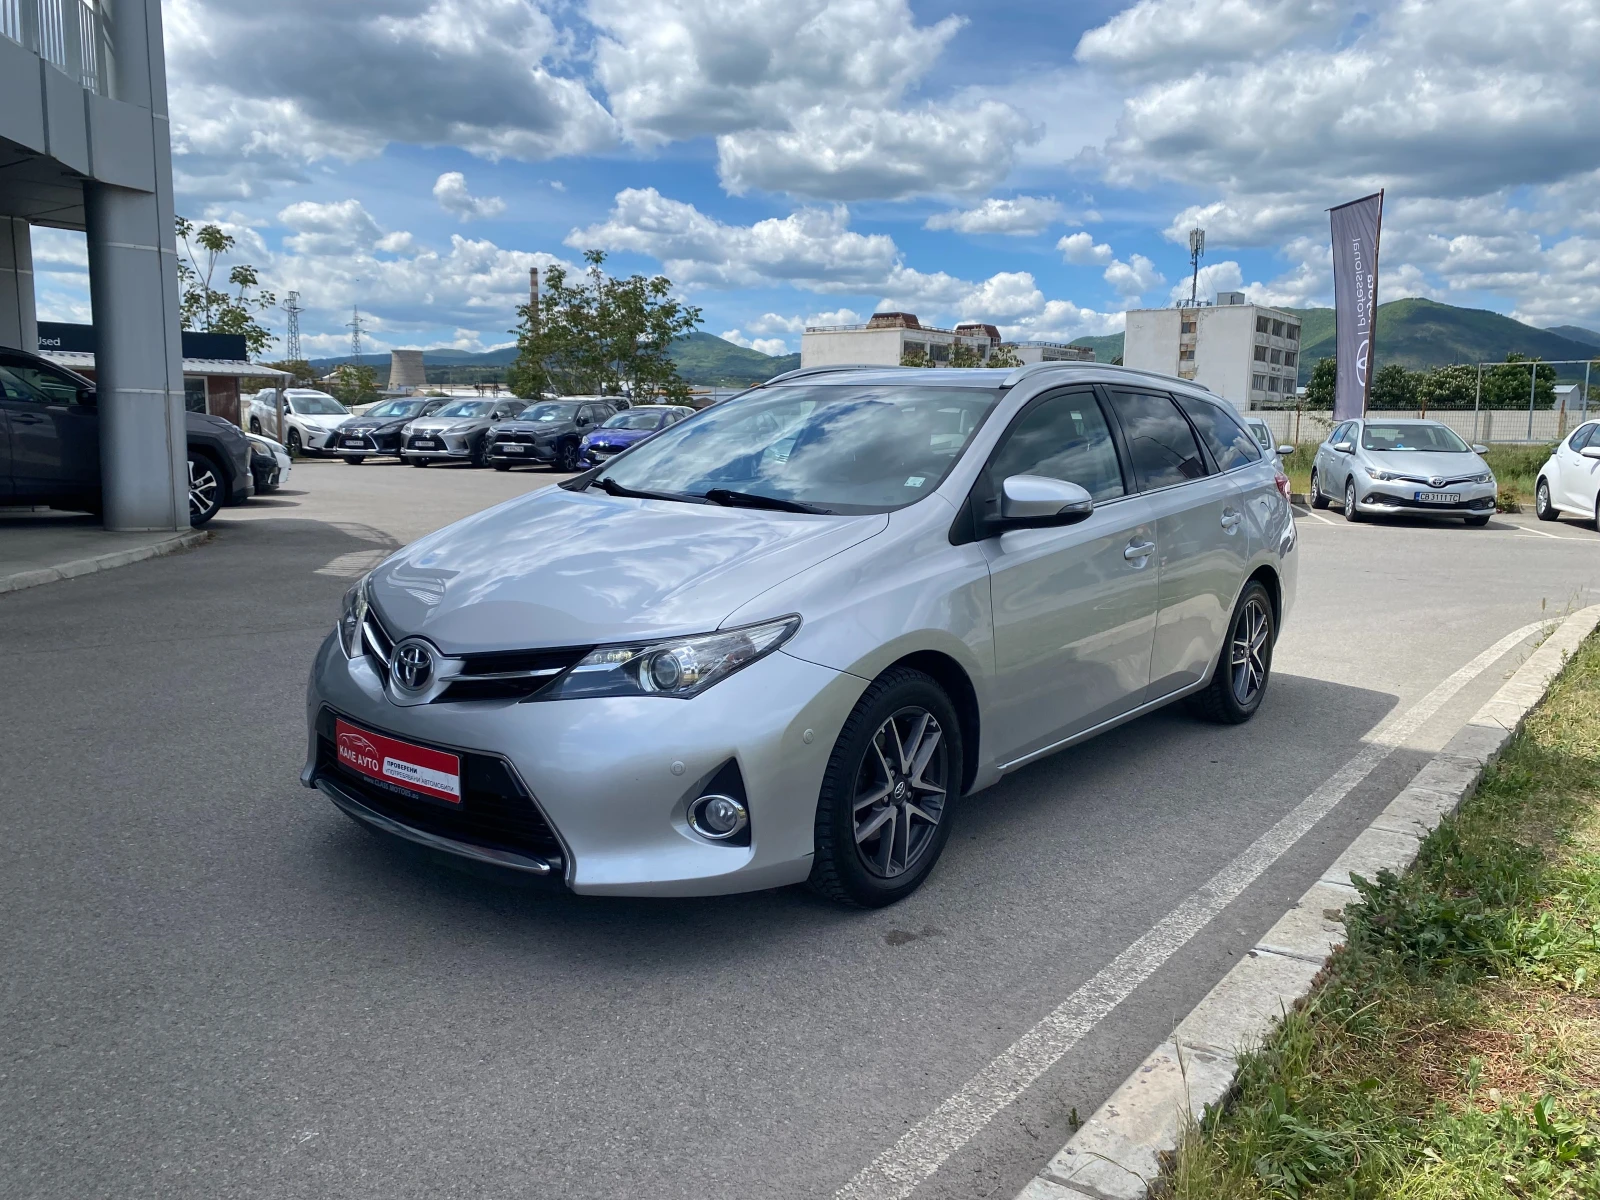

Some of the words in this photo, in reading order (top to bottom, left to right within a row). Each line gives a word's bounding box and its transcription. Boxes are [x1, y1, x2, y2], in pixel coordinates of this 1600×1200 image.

[339, 745, 357, 763] КАЛЕ
[357, 754, 379, 772] АУТО
[386, 760, 418, 774] ПРОВЕРЕНИ
